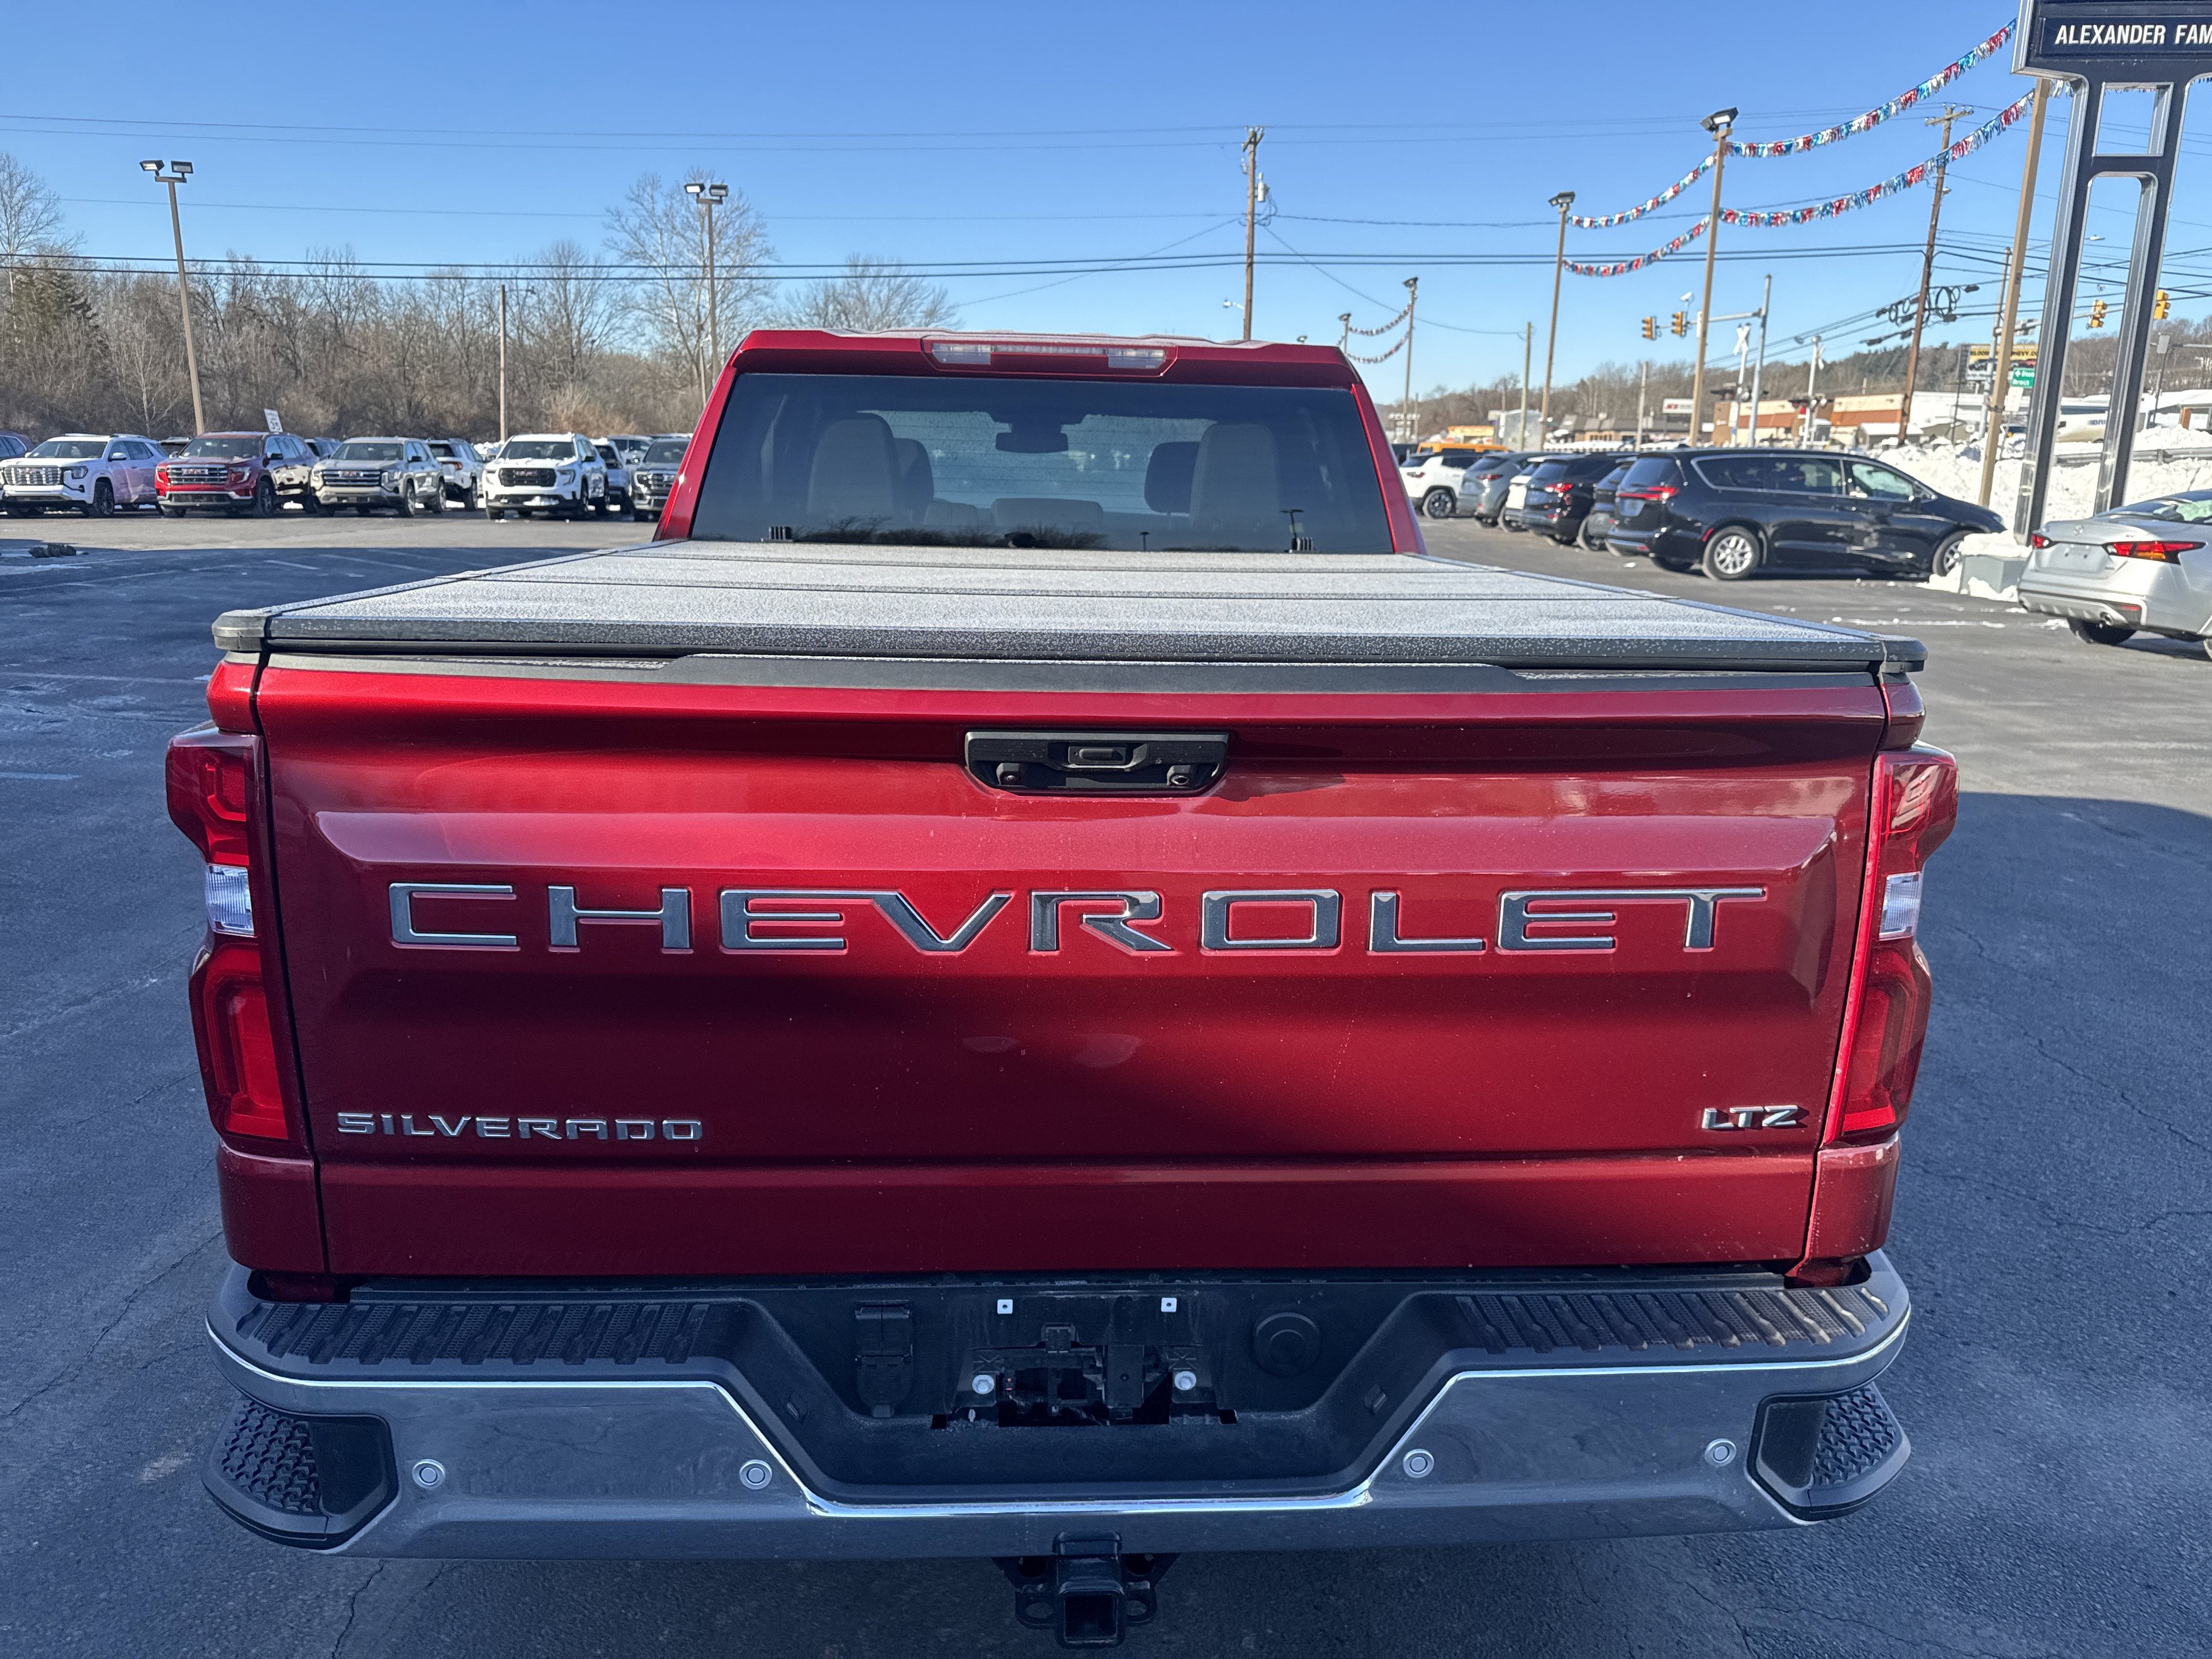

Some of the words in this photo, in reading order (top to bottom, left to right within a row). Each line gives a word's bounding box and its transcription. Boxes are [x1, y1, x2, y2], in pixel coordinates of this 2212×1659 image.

[2055, 24, 2166, 44] ALEXANDER
[270, 421, 281, 431] 35
[389, 882, 1765, 952] CHEVROLET
[336, 1111, 703, 1141] SILVERADO
[1702, 1105, 1798, 1129] LTZ
